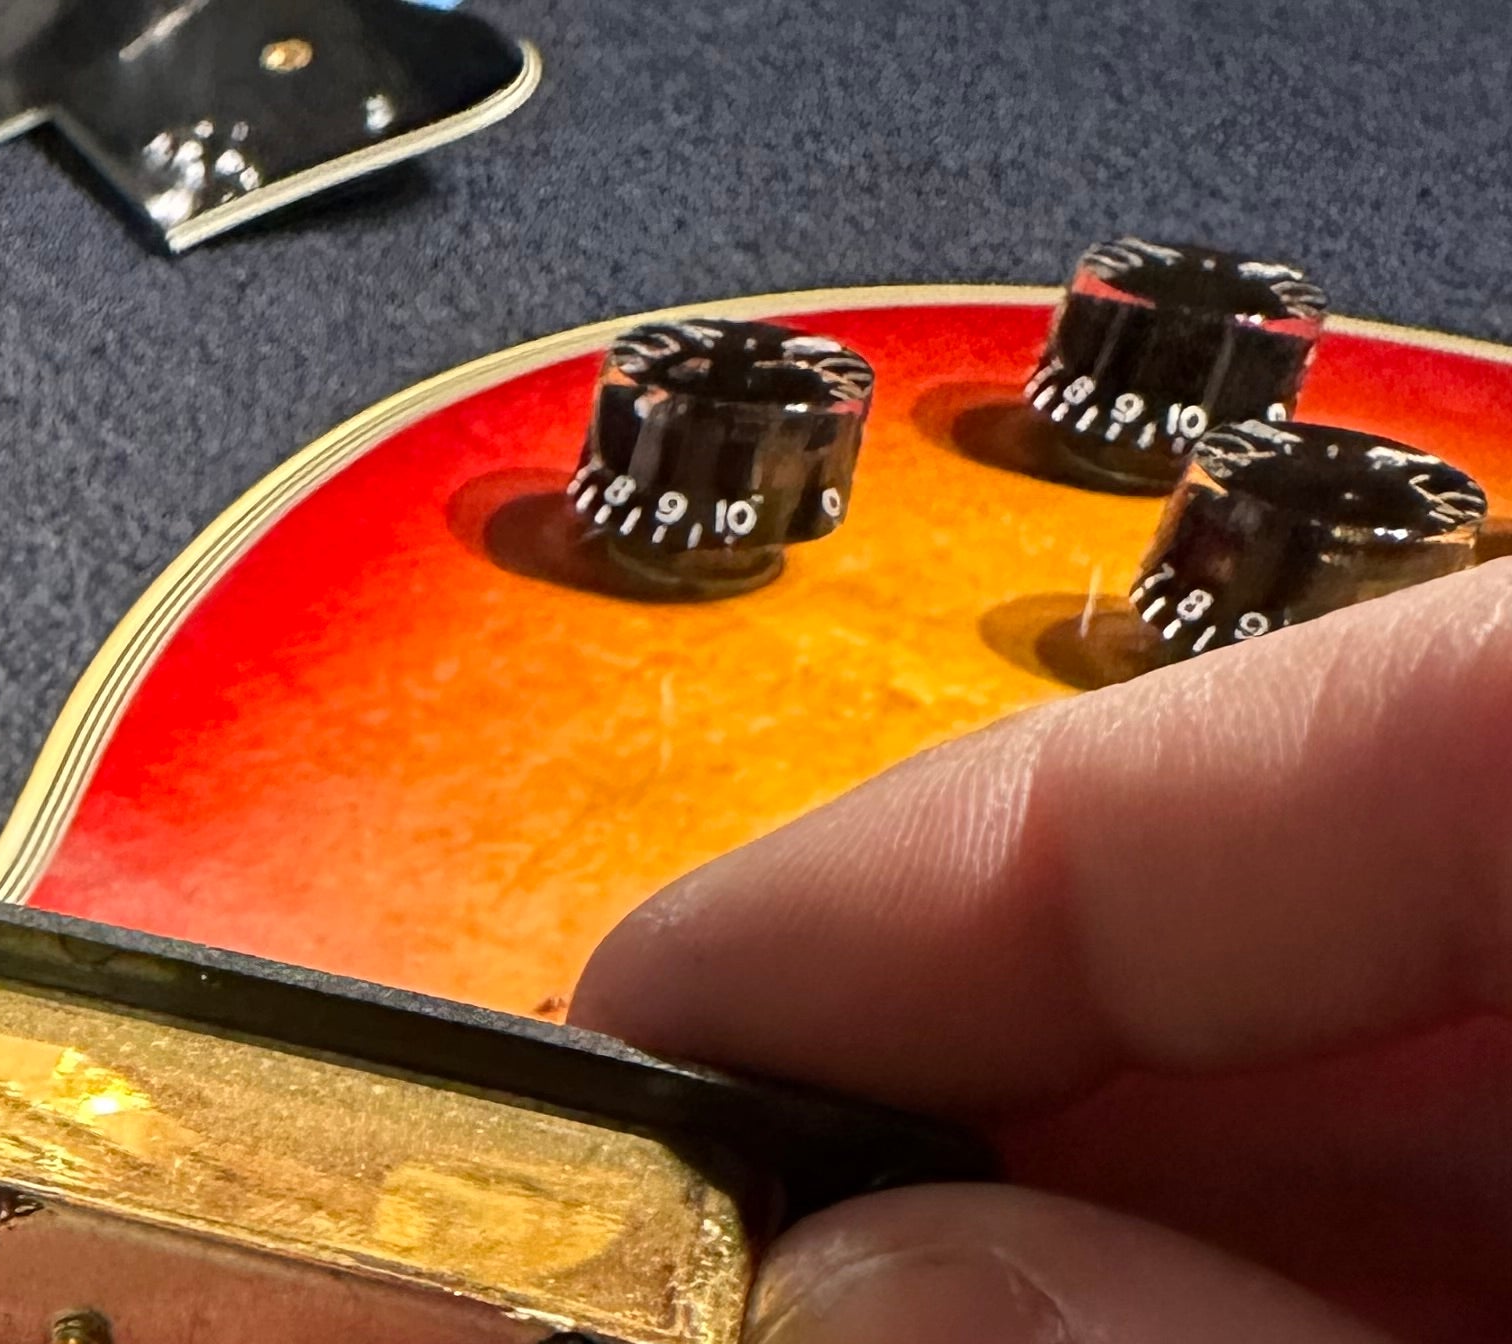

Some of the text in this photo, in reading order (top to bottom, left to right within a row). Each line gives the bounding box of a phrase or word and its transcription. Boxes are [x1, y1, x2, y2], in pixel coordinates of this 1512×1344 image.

[1062, 374, 1097, 406] 8
[1110, 392, 1145, 423] 9
[1166, 402, 1208, 439] 10
[603, 474, 637, 507] 8
[654, 489, 689, 525] 9
[714, 498, 758, 535] 10
[820, 487, 842, 518] 0
[1175, 588, 1216, 621] 8
